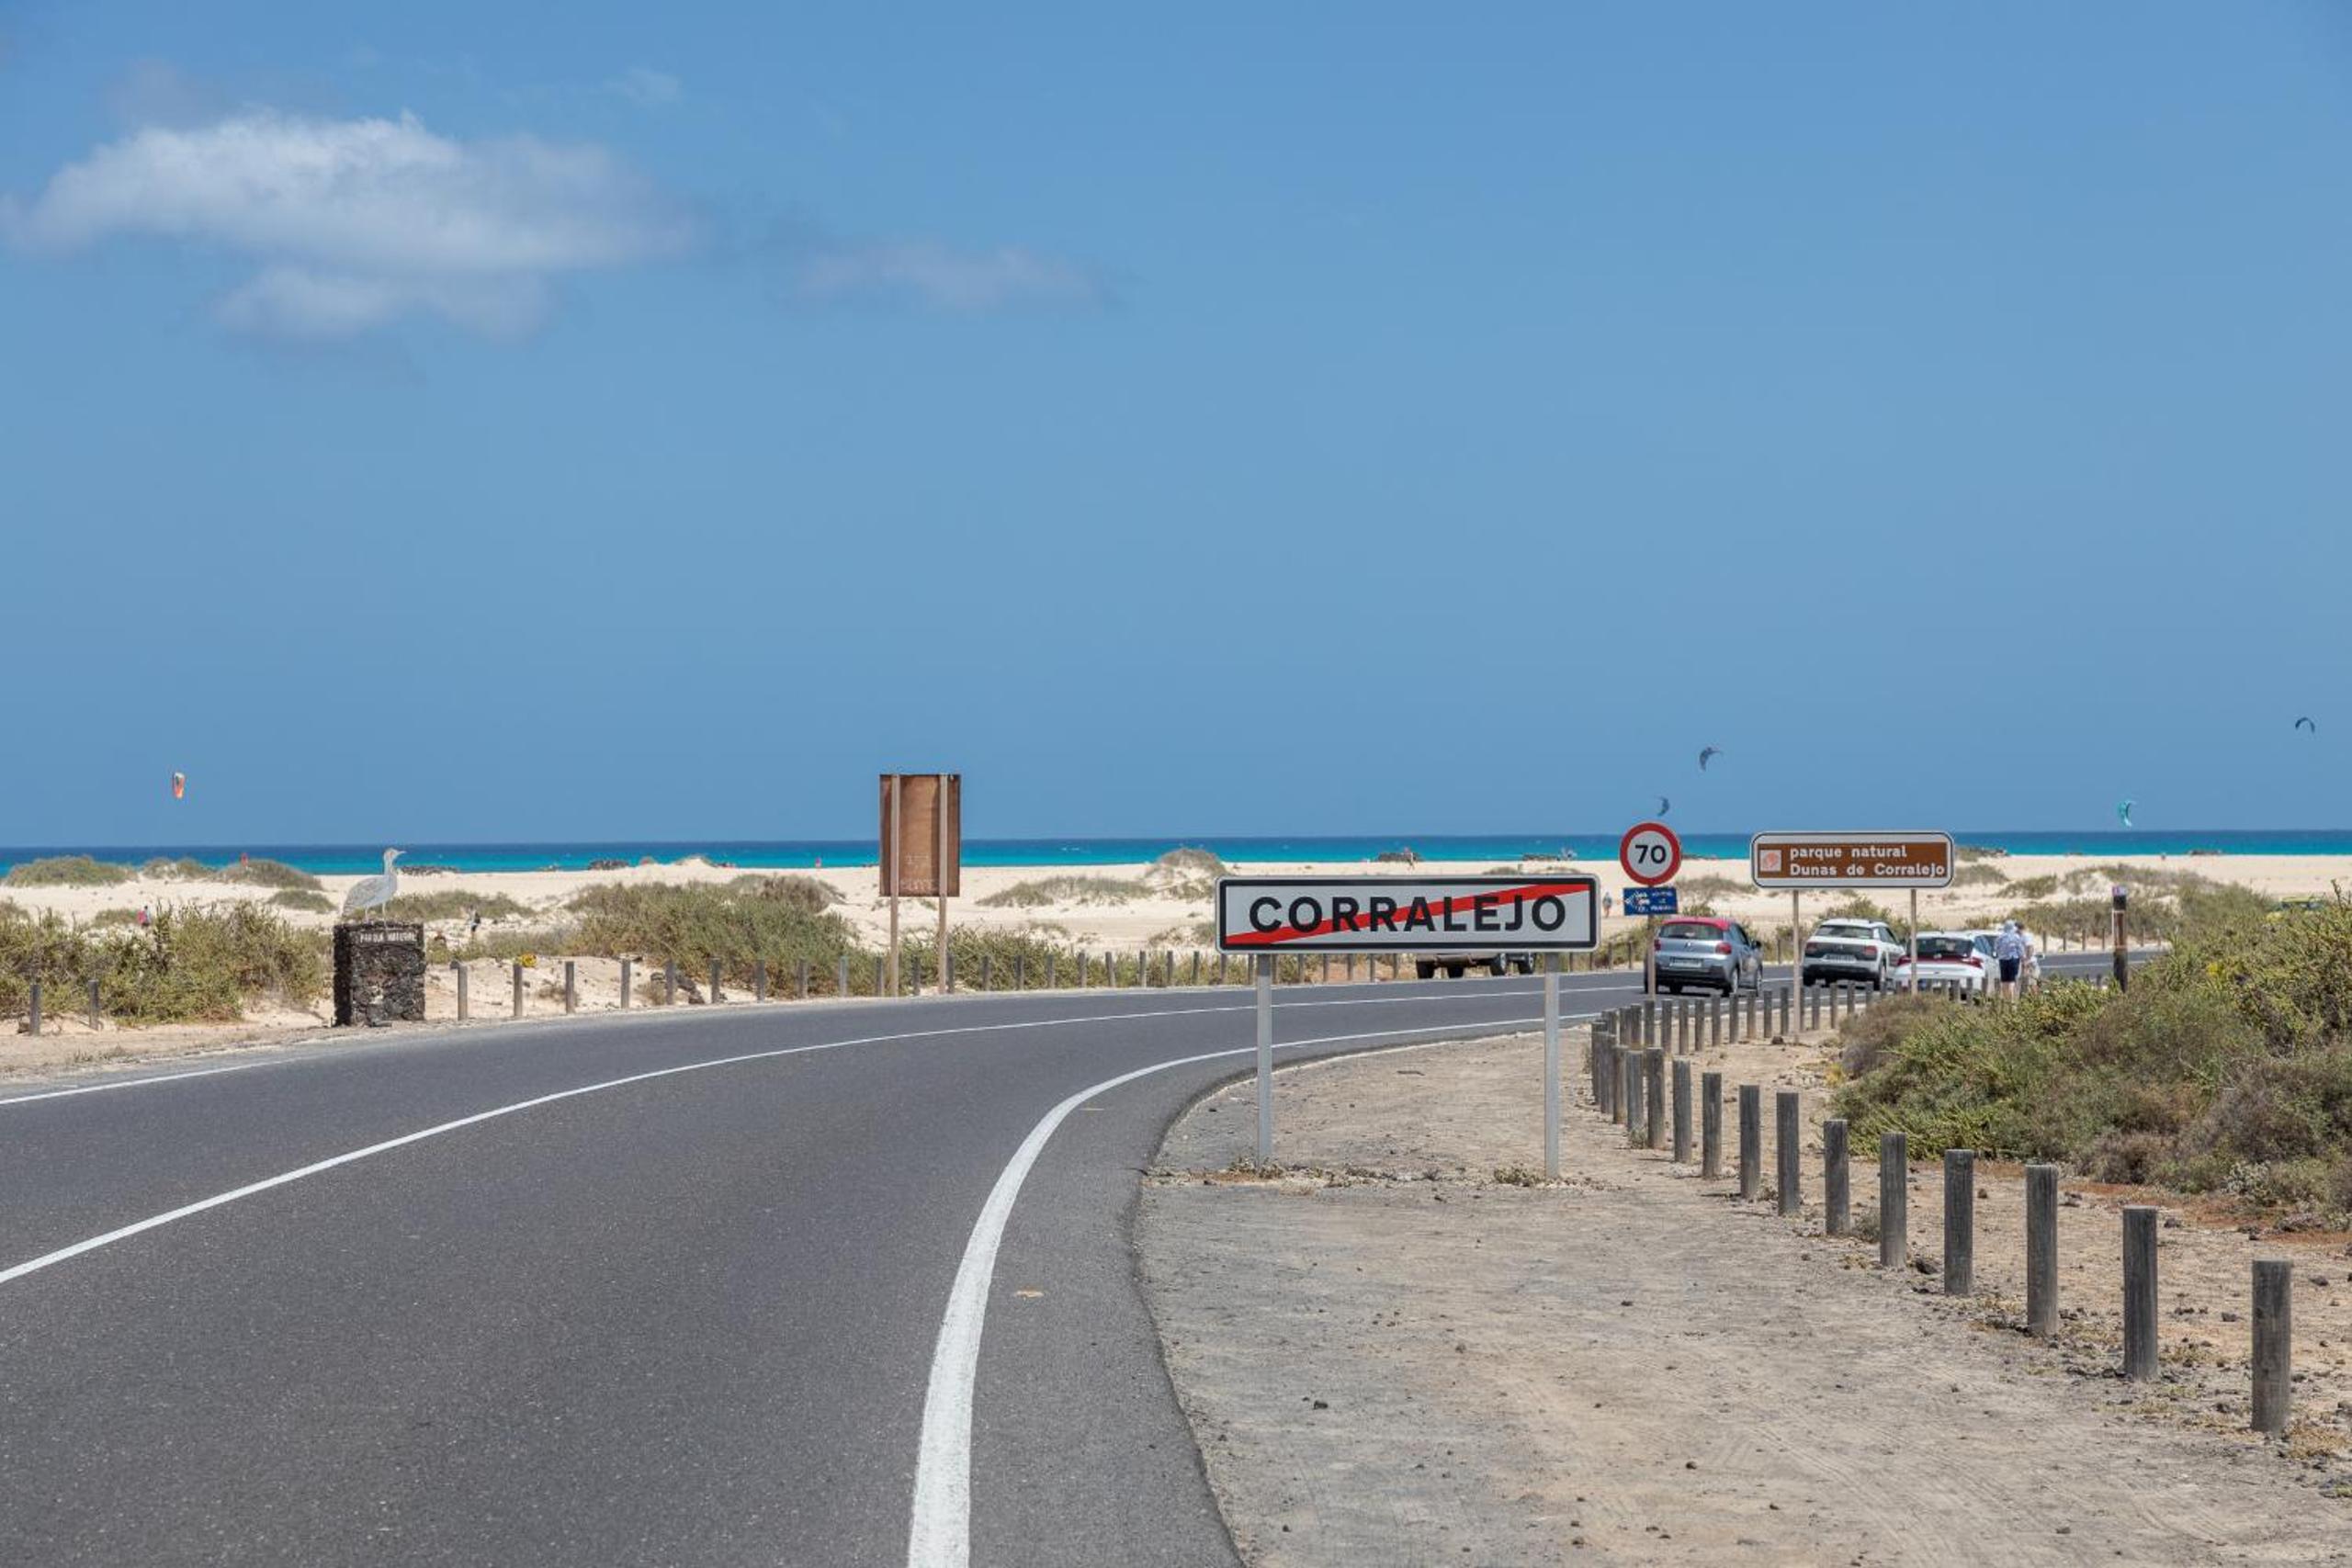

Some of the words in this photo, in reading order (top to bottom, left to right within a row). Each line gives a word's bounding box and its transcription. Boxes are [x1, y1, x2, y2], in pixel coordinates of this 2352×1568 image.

[1635, 845, 1667, 864] 70
[1790, 847, 1842, 861] parque
[1851, 845, 1907, 858] natural
[1791, 863, 1838, 876] Dunas
[1847, 863, 1865, 876] de
[1874, 863, 1945, 877] Corralejo
[1249, 895, 1566, 933] CORRALEJO
